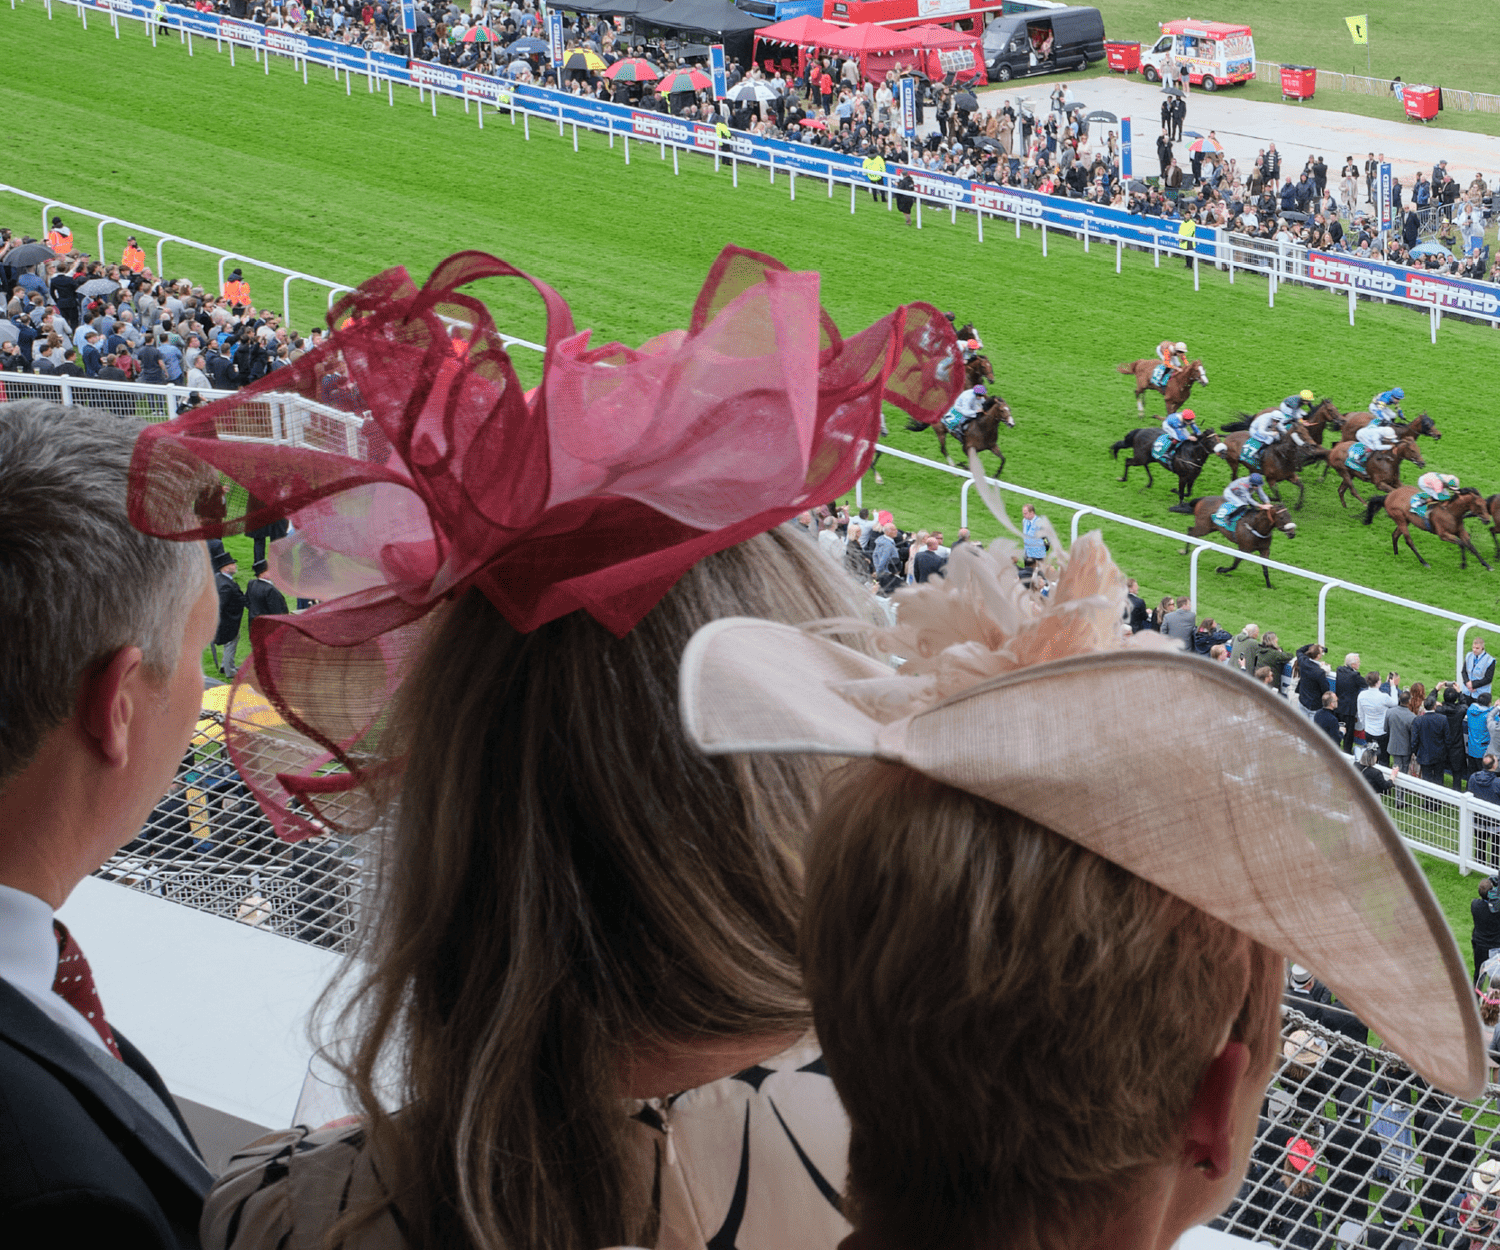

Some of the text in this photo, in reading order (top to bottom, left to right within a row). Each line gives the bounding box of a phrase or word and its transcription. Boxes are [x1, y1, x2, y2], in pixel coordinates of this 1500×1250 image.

[554, 24, 562, 60] BETFRED
[905, 88, 913, 129] BETFRED
[635, 115, 688, 141] BETFRED
[697, 129, 753, 155] BERED
[974, 188, 1042, 216] BETFRED
[1314, 254, 1396, 292] BETFRED
[1410, 278, 1498, 313] BETFRED
